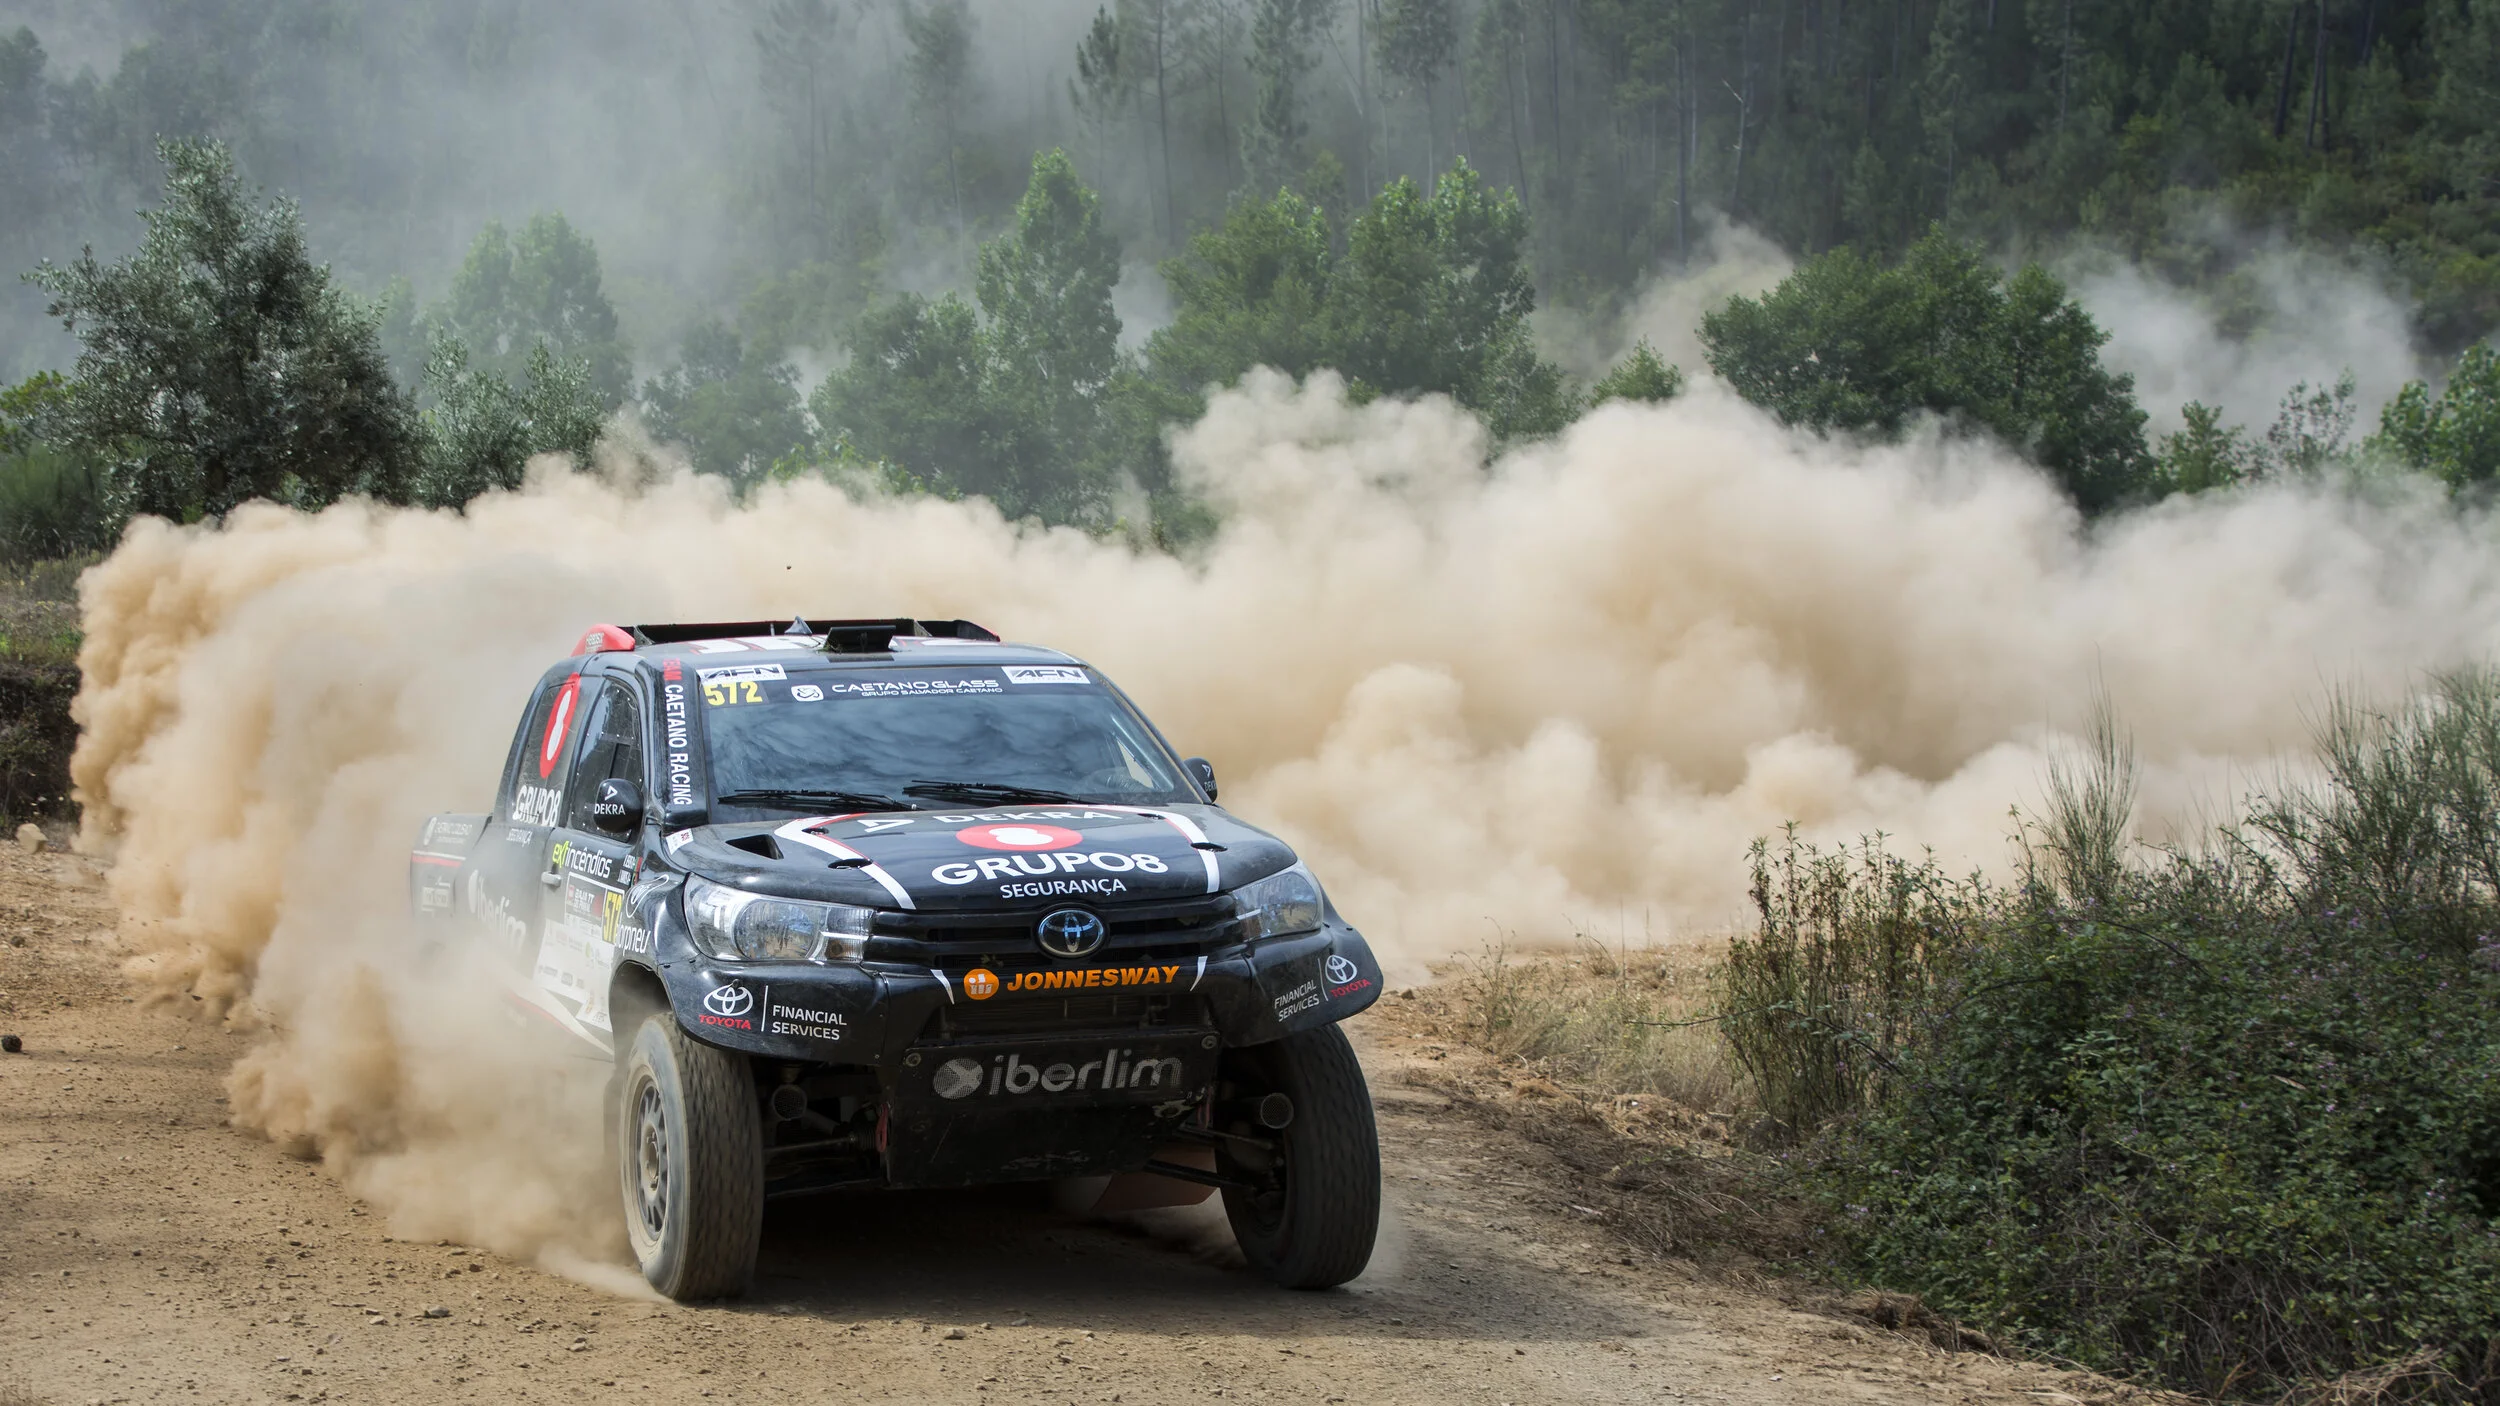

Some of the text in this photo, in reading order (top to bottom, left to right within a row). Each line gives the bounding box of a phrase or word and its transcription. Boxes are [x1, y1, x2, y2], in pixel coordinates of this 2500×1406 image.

[706, 667, 780, 679] AFN
[1015, 669, 1082, 678] AFN
[704, 681, 763, 706] 572
[832, 679, 999, 693] CAETANO GLASS
[861, 689, 899, 697] GRUPO
[901, 688, 953, 696] SALVADOR
[664, 684, 687, 748] CAETANO
[669, 752, 693, 805] RACING
[515, 784, 562, 828] GRUPO8
[594, 803, 626, 816] DEKRA
[932, 811, 1123, 823] DEKRA
[931, 851, 1169, 885] GRUPO8
[1000, 878, 1127, 900] SEGURANÇA
[1007, 965, 1180, 991] JONNESWAY
[1330, 979, 1372, 998] TOYOTA
[1274, 980, 1317, 1009] FINANCIAL
[772, 1004, 847, 1026] FINANCIAL
[1278, 993, 1320, 1022] SERVICES
[699, 1014, 751, 1030] TOYOTA
[771, 1021, 840, 1041] SERVICES
[989, 1048, 1182, 1096] iberlim
